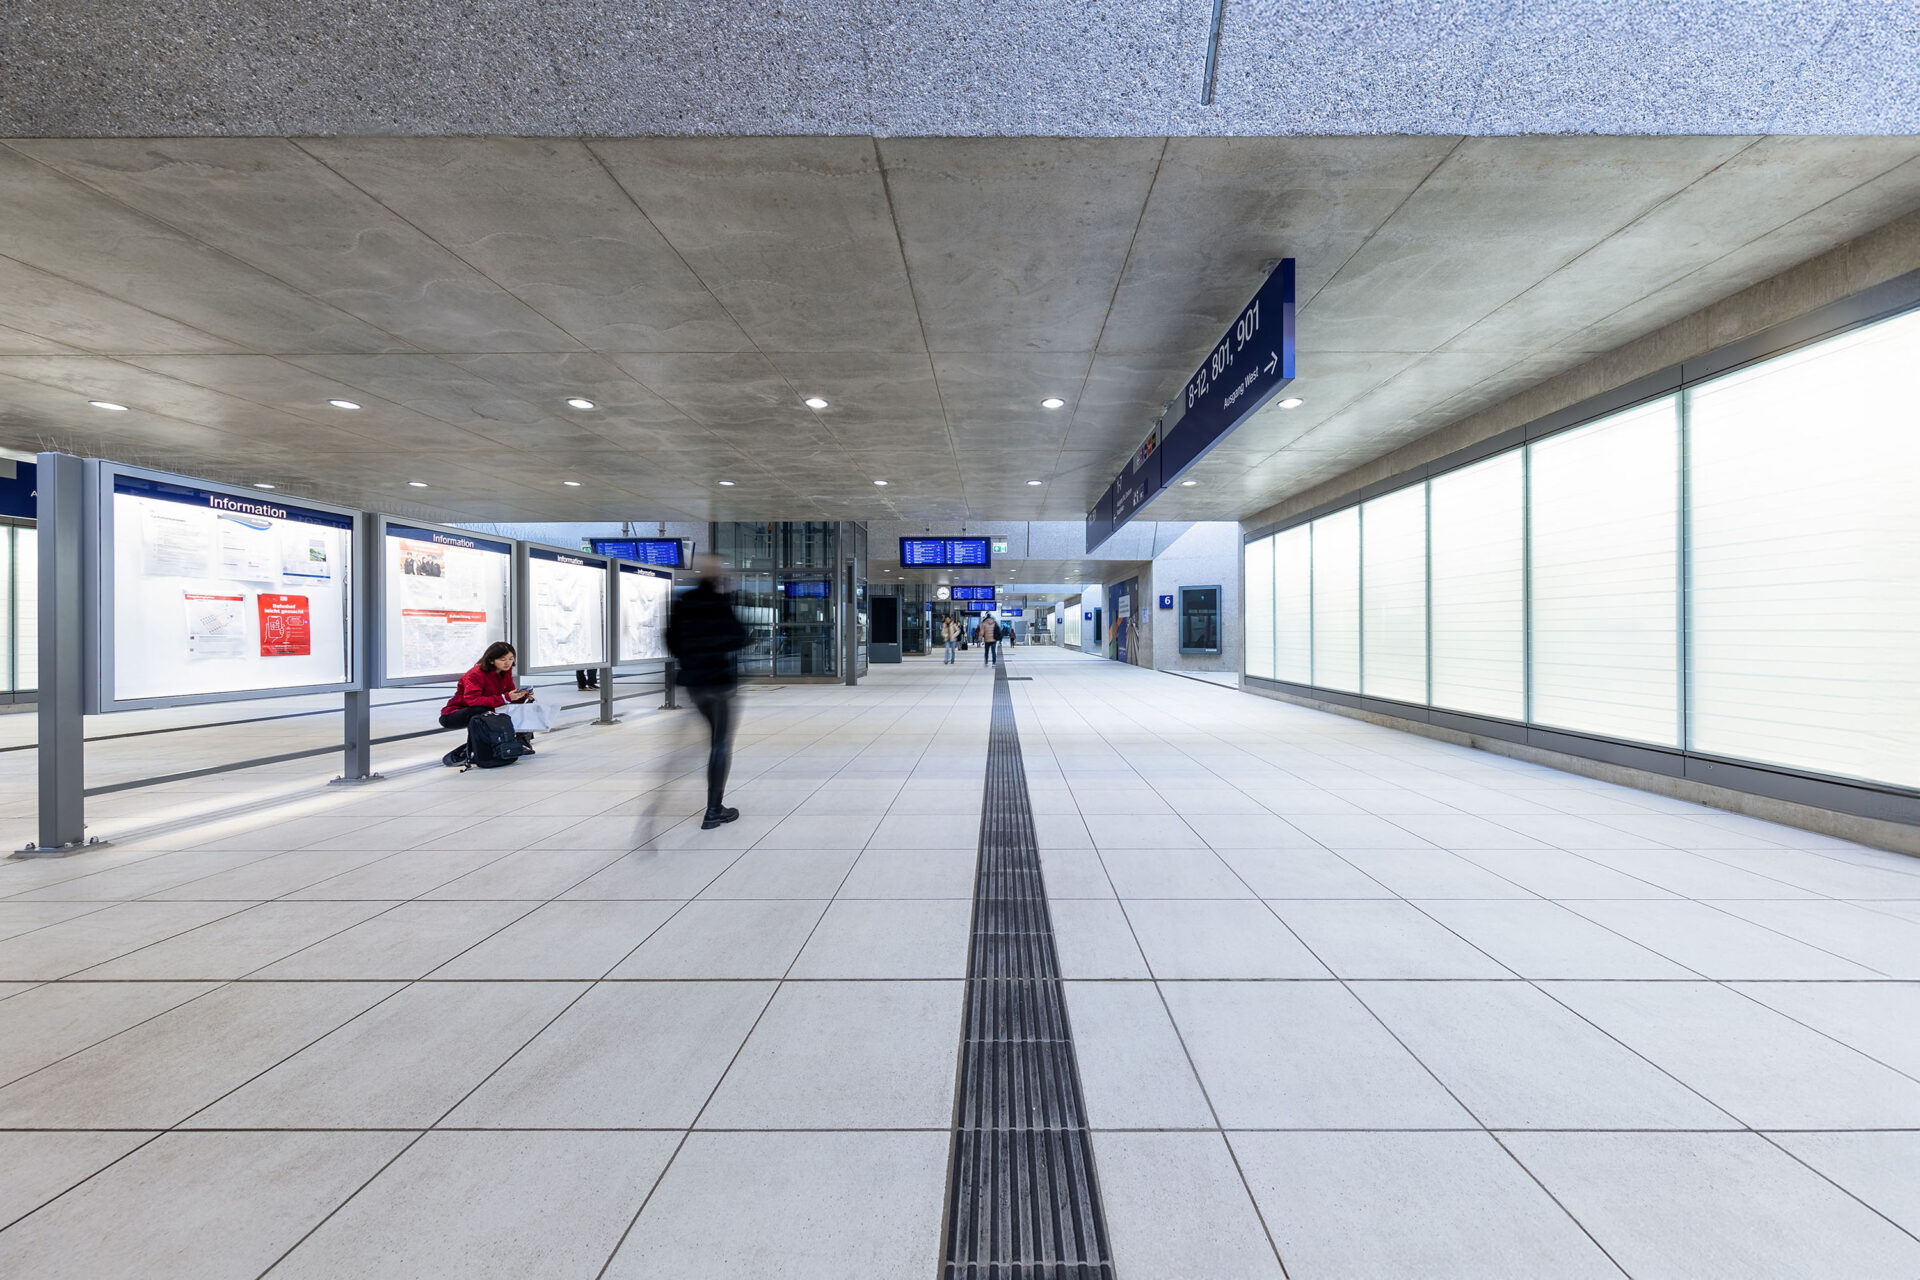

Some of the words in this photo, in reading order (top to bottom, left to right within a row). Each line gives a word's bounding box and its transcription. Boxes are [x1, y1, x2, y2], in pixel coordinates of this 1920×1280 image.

[1188, 368, 1209, 408] 8-12,
[1211, 337, 1233, 380] 801,
[1237, 299, 1259, 351] 901
[1223, 383, 1245, 409] Ausgang
[1245, 366, 1259, 388] West
[209, 495, 287, 519] Information
[432, 534, 474, 548] Information
[557, 555, 584, 565] Information
